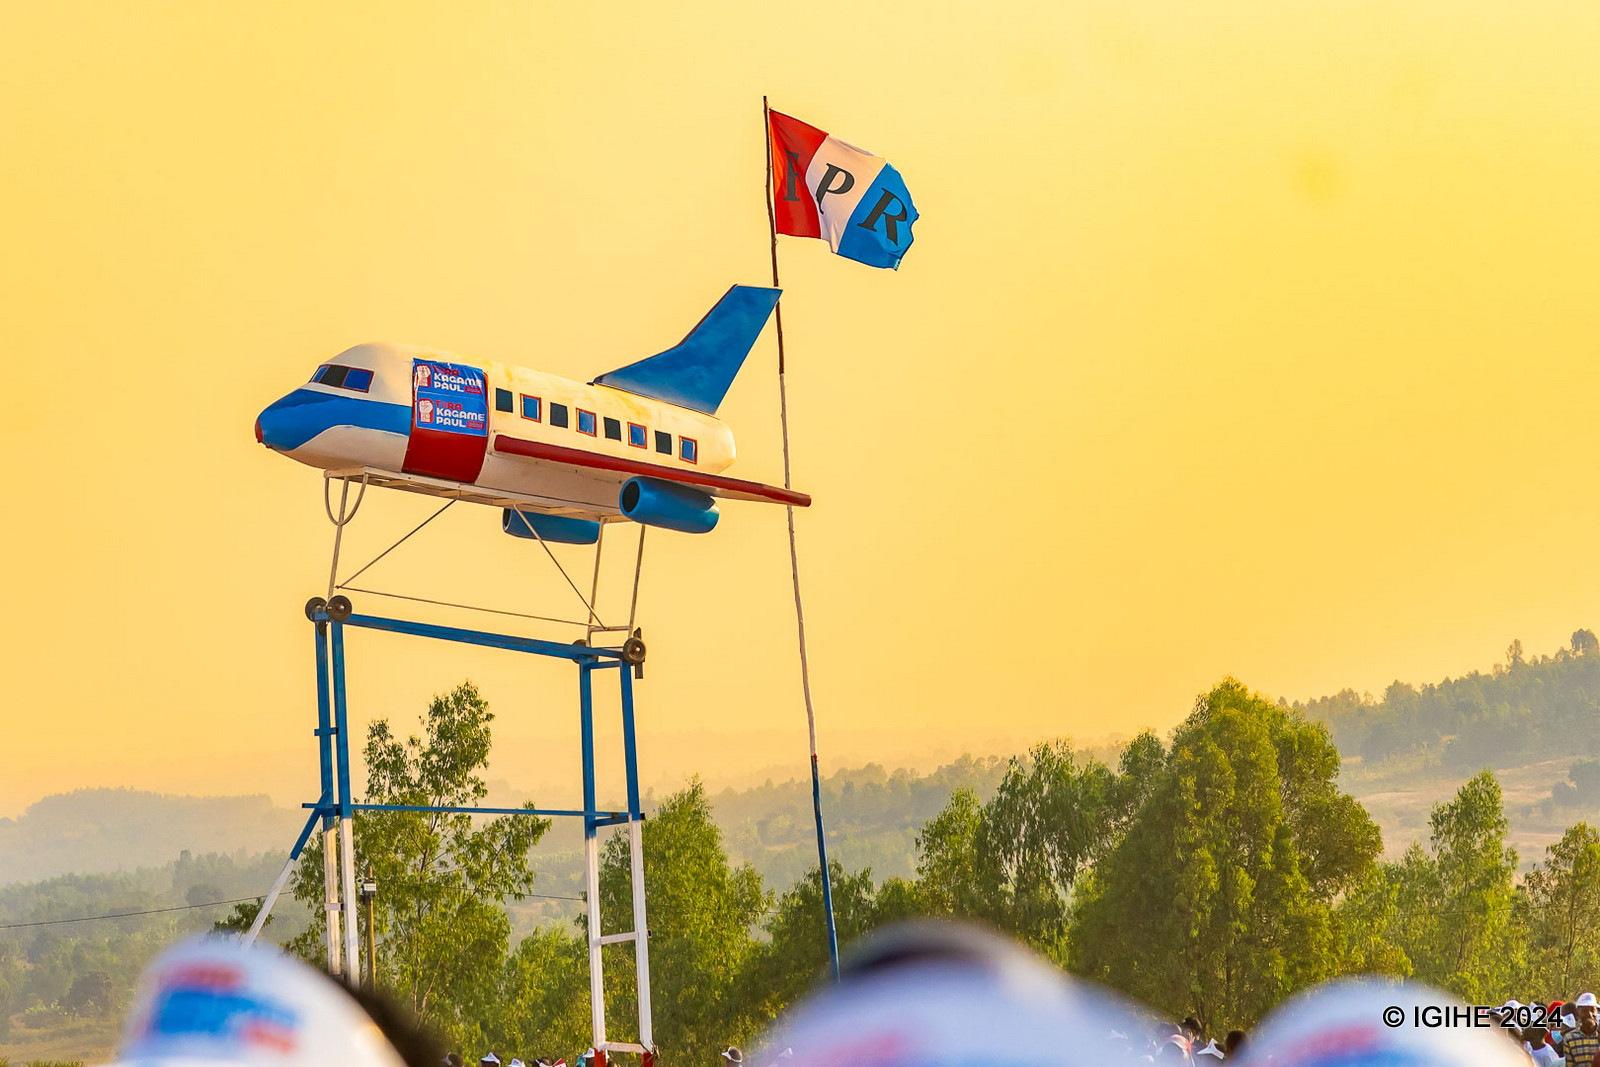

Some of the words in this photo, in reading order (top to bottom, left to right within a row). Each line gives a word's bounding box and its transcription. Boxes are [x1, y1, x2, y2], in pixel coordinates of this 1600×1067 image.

[434, 381, 465, 393] PAUL
[436, 407, 485, 421] KAGAME
[436, 416, 467, 428] PAUL
